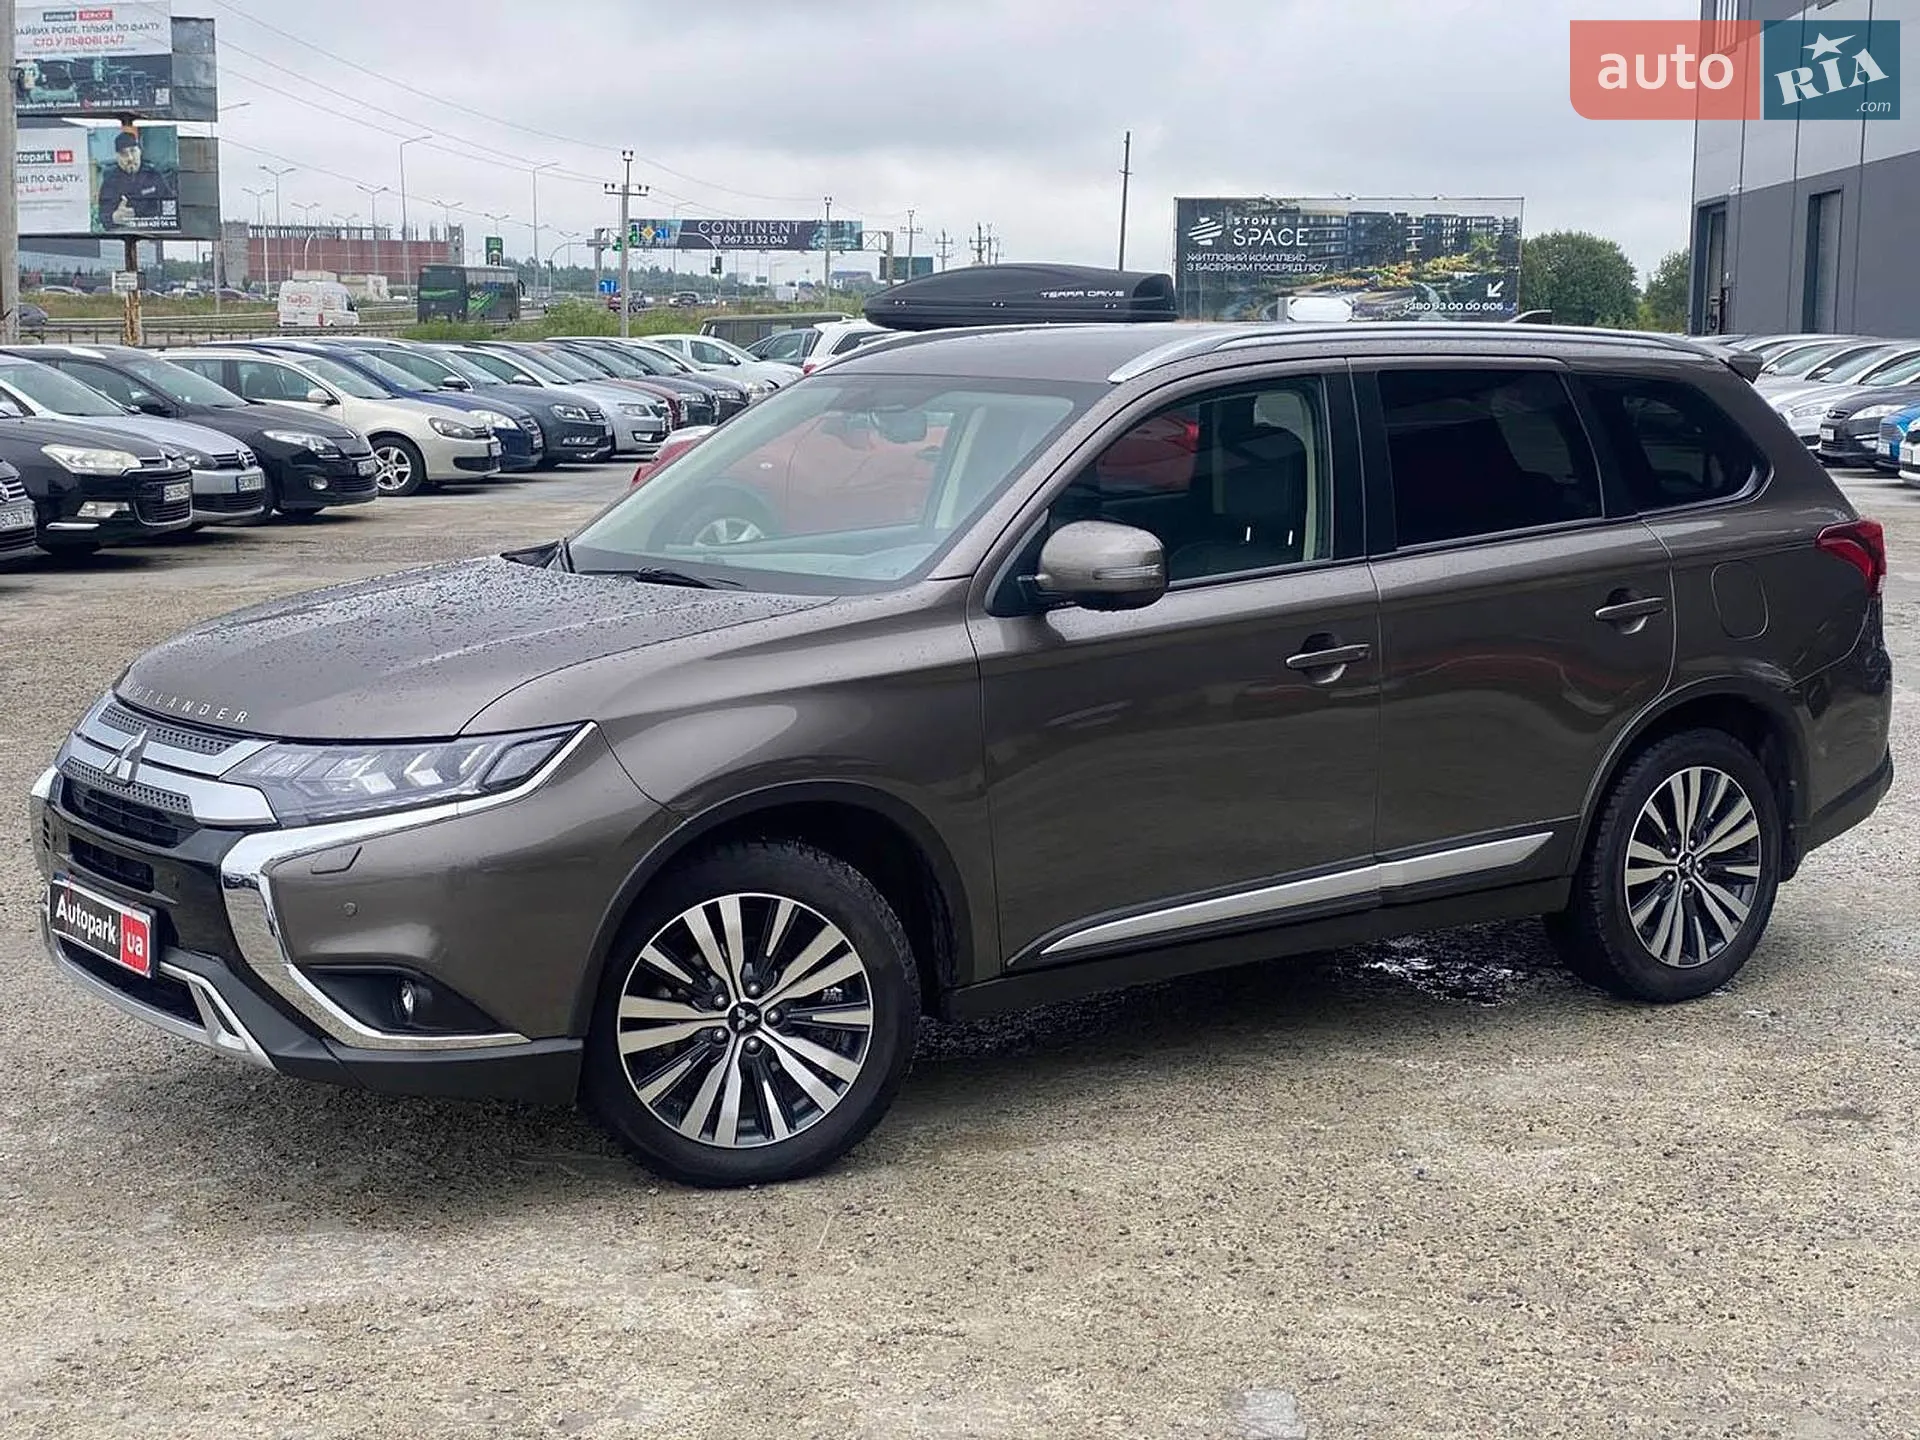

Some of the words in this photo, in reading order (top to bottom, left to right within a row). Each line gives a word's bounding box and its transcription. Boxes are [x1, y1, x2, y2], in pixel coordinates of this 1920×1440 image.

[698, 221, 800, 234] CONTINENT
[1233, 217, 1278, 225] STONE
[1233, 228, 1309, 246] SPACE
[1040, 290, 1085, 298] TERRA
[56, 894, 117, 945] Autopark
[126, 931, 144, 957] ua
